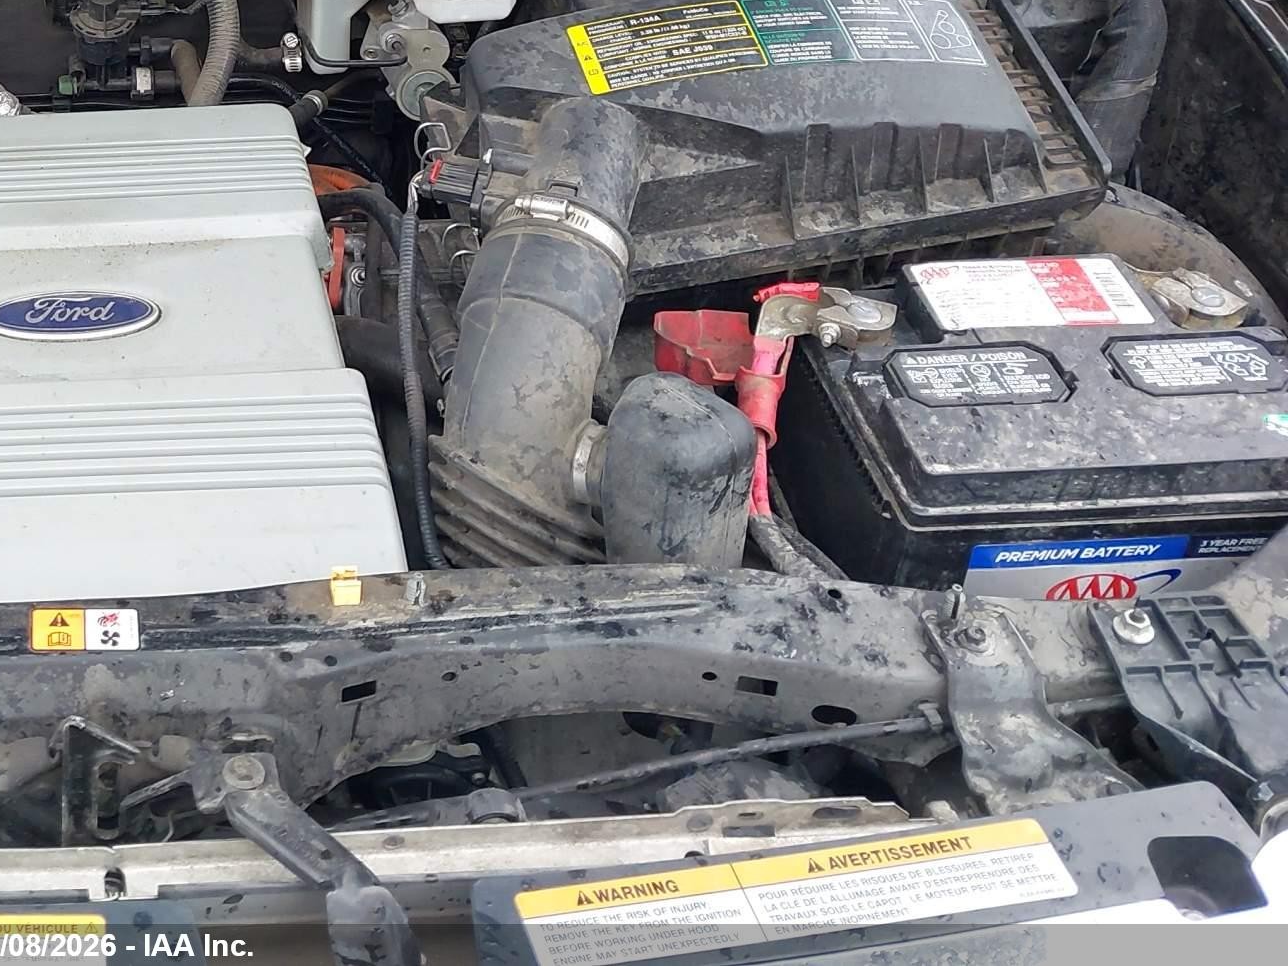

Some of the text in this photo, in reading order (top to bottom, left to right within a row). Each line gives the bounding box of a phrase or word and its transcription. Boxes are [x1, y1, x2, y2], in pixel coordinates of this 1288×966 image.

[630, 15, 662, 26] R-134A
[672, 47, 692, 56] SAE
[23, 294, 117, 324] Ford
[917, 353, 969, 364] DANGER
[979, 351, 1027, 362] POISON
[995, 544, 1162, 563] PREMIUM BATTERY
[1209, 538, 1238, 547] YEAR
[828, 835, 974, 871] AVERTISSEMENT
[759, 889, 789, 901] POUR
[839, 878, 860, 890] LES
[861, 871, 907, 886] RISQUES
[910, 870, 924, 880] DE
[990, 852, 1034, 866] RETIRER
[764, 901, 779, 913] LA
[803, 896, 818, 907] DE
[889, 881, 921, 894] AVANT
[1019, 863, 1041, 874] DES
[593, 880, 680, 903] WARNING
[770, 872, 1061, 923] TRAVAUX SOUS LE LE MOTEUR PEUT SE METTRE
[540, 923, 554, 932] TO
[557, 916, 600, 930] REDUCE
[602, 913, 624, 923] THE
[626, 907, 651, 920] RISK
[653, 907, 668, 916] OF
[544, 908, 742, 944] REMOVE THE KEY FROM THE IGNITION
[775, 925, 790, 935] EN
[792, 919, 839, 933] MARCHE
[548, 923, 720, 956] BEFORE WORKING UNDER HOOD
[552, 931, 741, 966] ENGINE MAY START UNEXPECTEDLY
